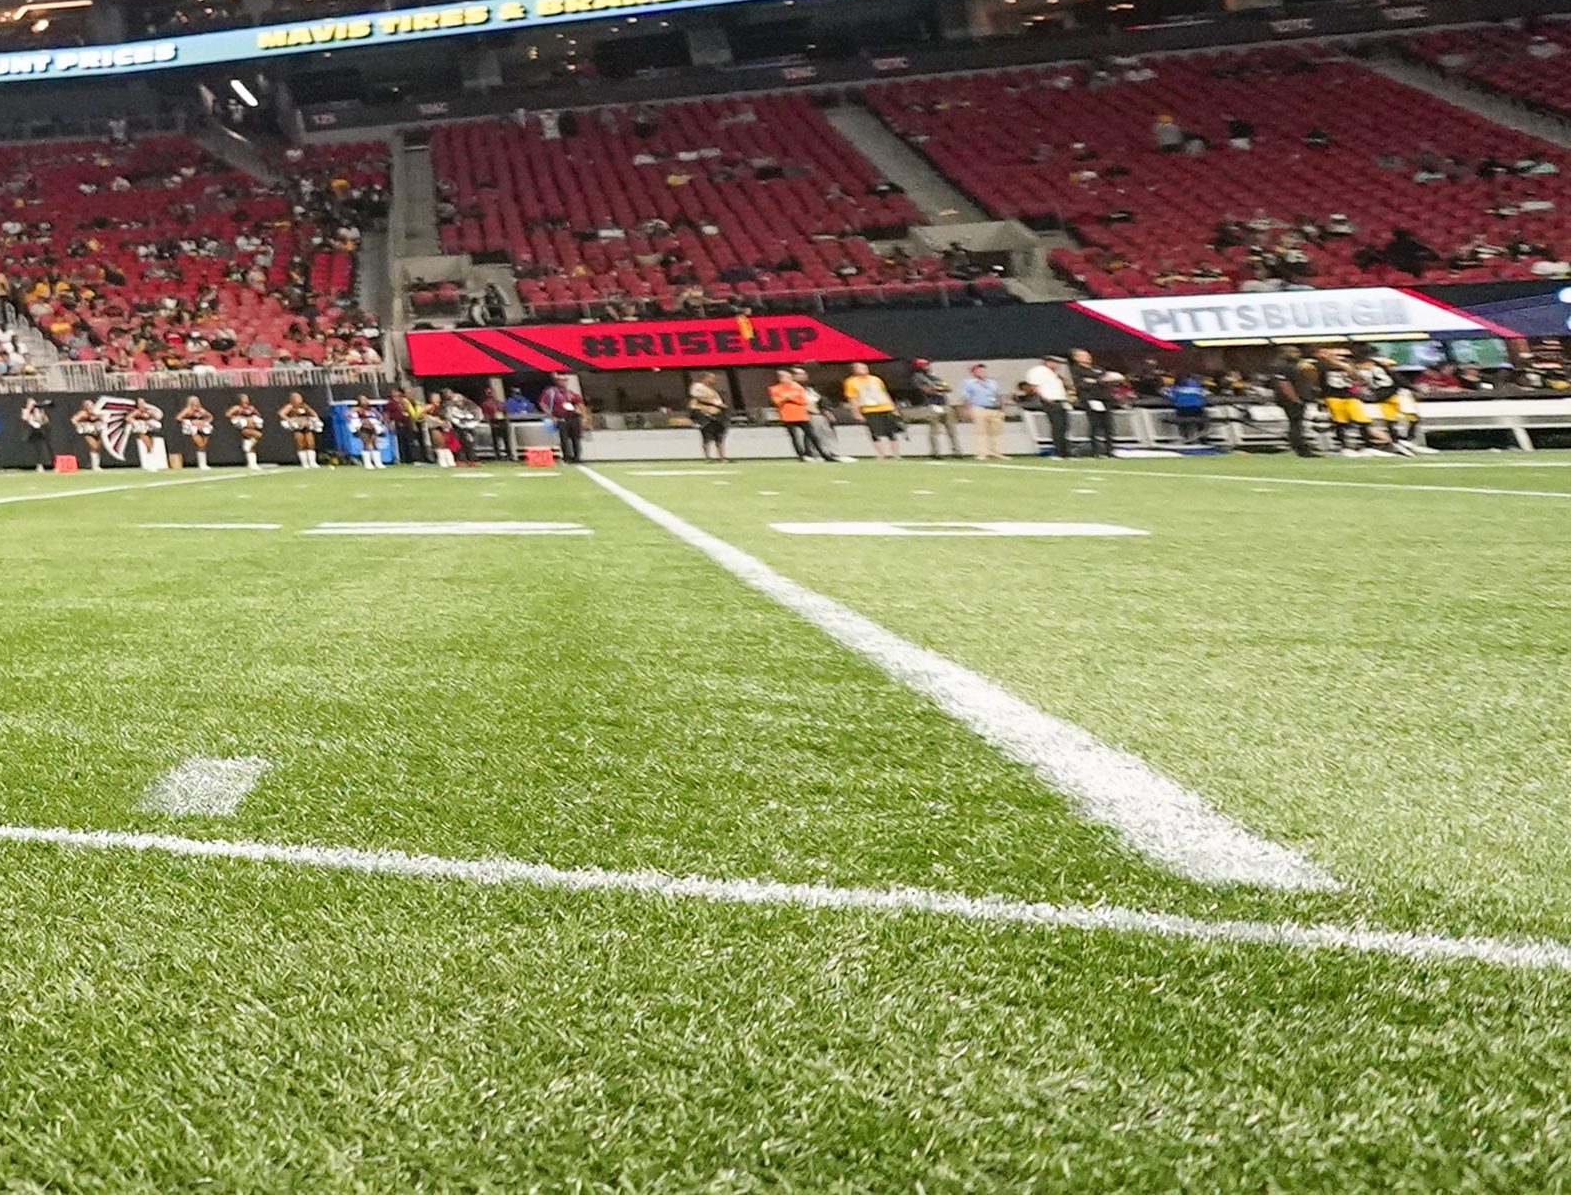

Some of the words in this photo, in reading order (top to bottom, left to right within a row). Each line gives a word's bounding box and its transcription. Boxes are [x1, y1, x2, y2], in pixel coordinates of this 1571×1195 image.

[256, 20, 373, 49] MAVIS
[377, 6, 490, 34] TIRES
[497, 2, 526, 20] &
[58, 43, 178, 71] PRICES
[1140, 298, 1413, 335] PITTSBURGH
[580, 325, 819, 358] #RISEUP
